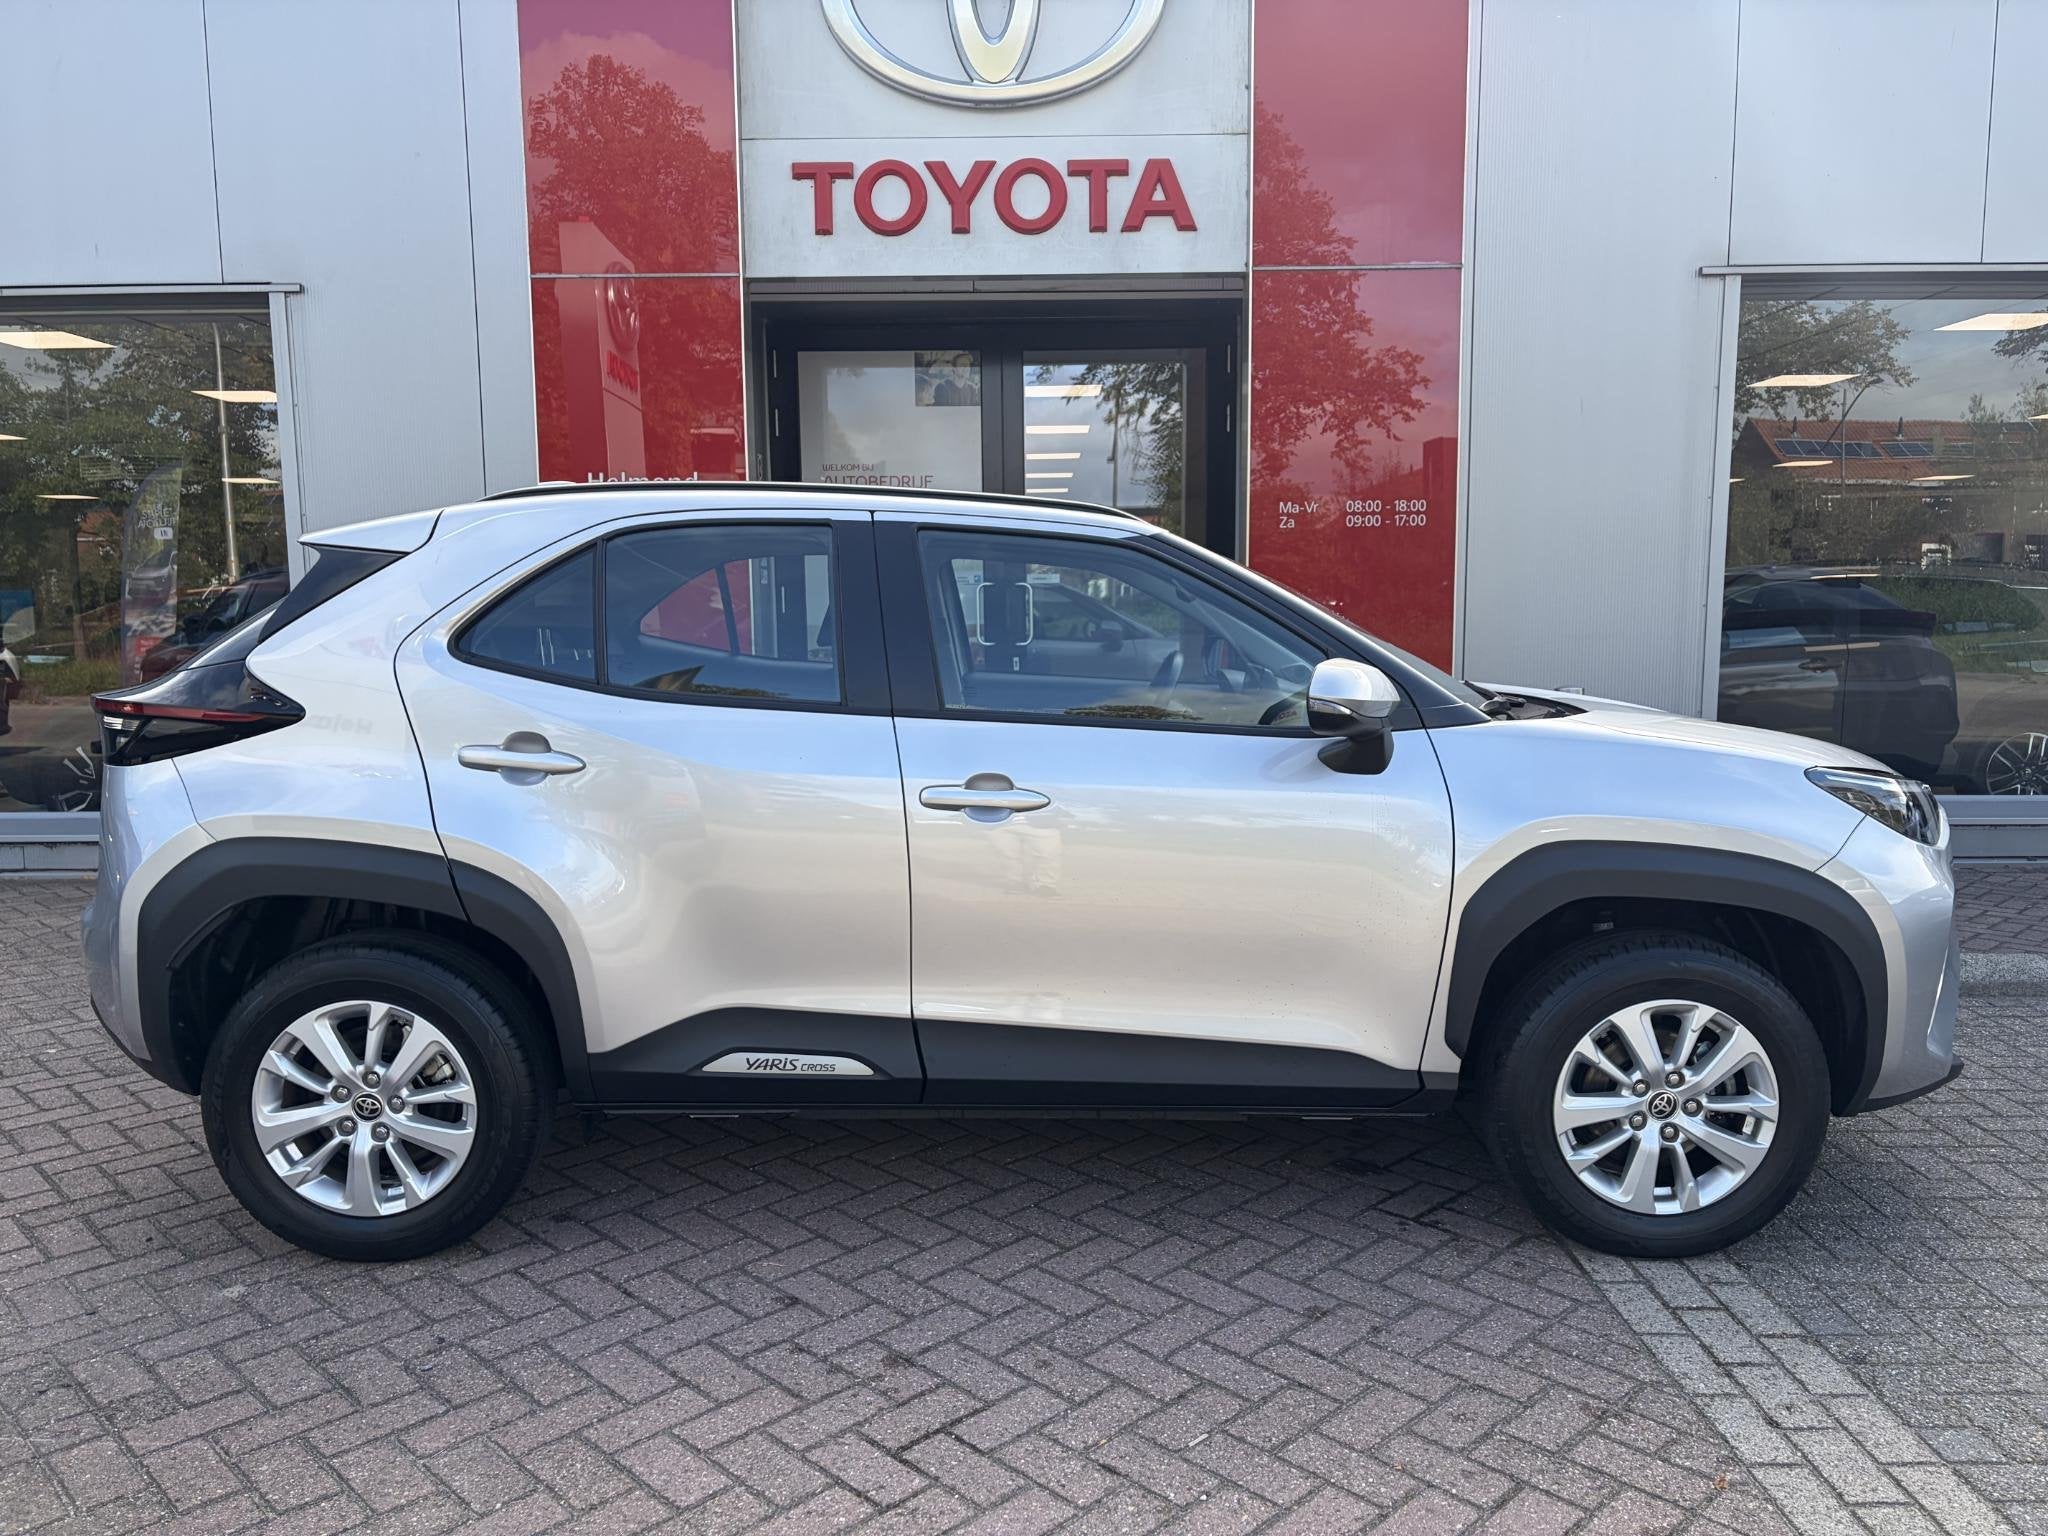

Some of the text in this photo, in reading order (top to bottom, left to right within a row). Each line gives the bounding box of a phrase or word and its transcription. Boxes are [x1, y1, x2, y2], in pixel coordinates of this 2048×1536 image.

[792, 157, 1198, 236] TOYOTA
[822, 463, 860, 472] WELKOM
[1279, 501, 1319, 513] Ma-Vr
[1345, 500, 1382, 513] 08:00
[1394, 499, 1427, 512] 18:00
[1279, 516, 1295, 529] Za
[1345, 514, 1382, 527] 09:00
[1394, 514, 1427, 526] 17:00
[800, 1063, 837, 1072] CROSS
